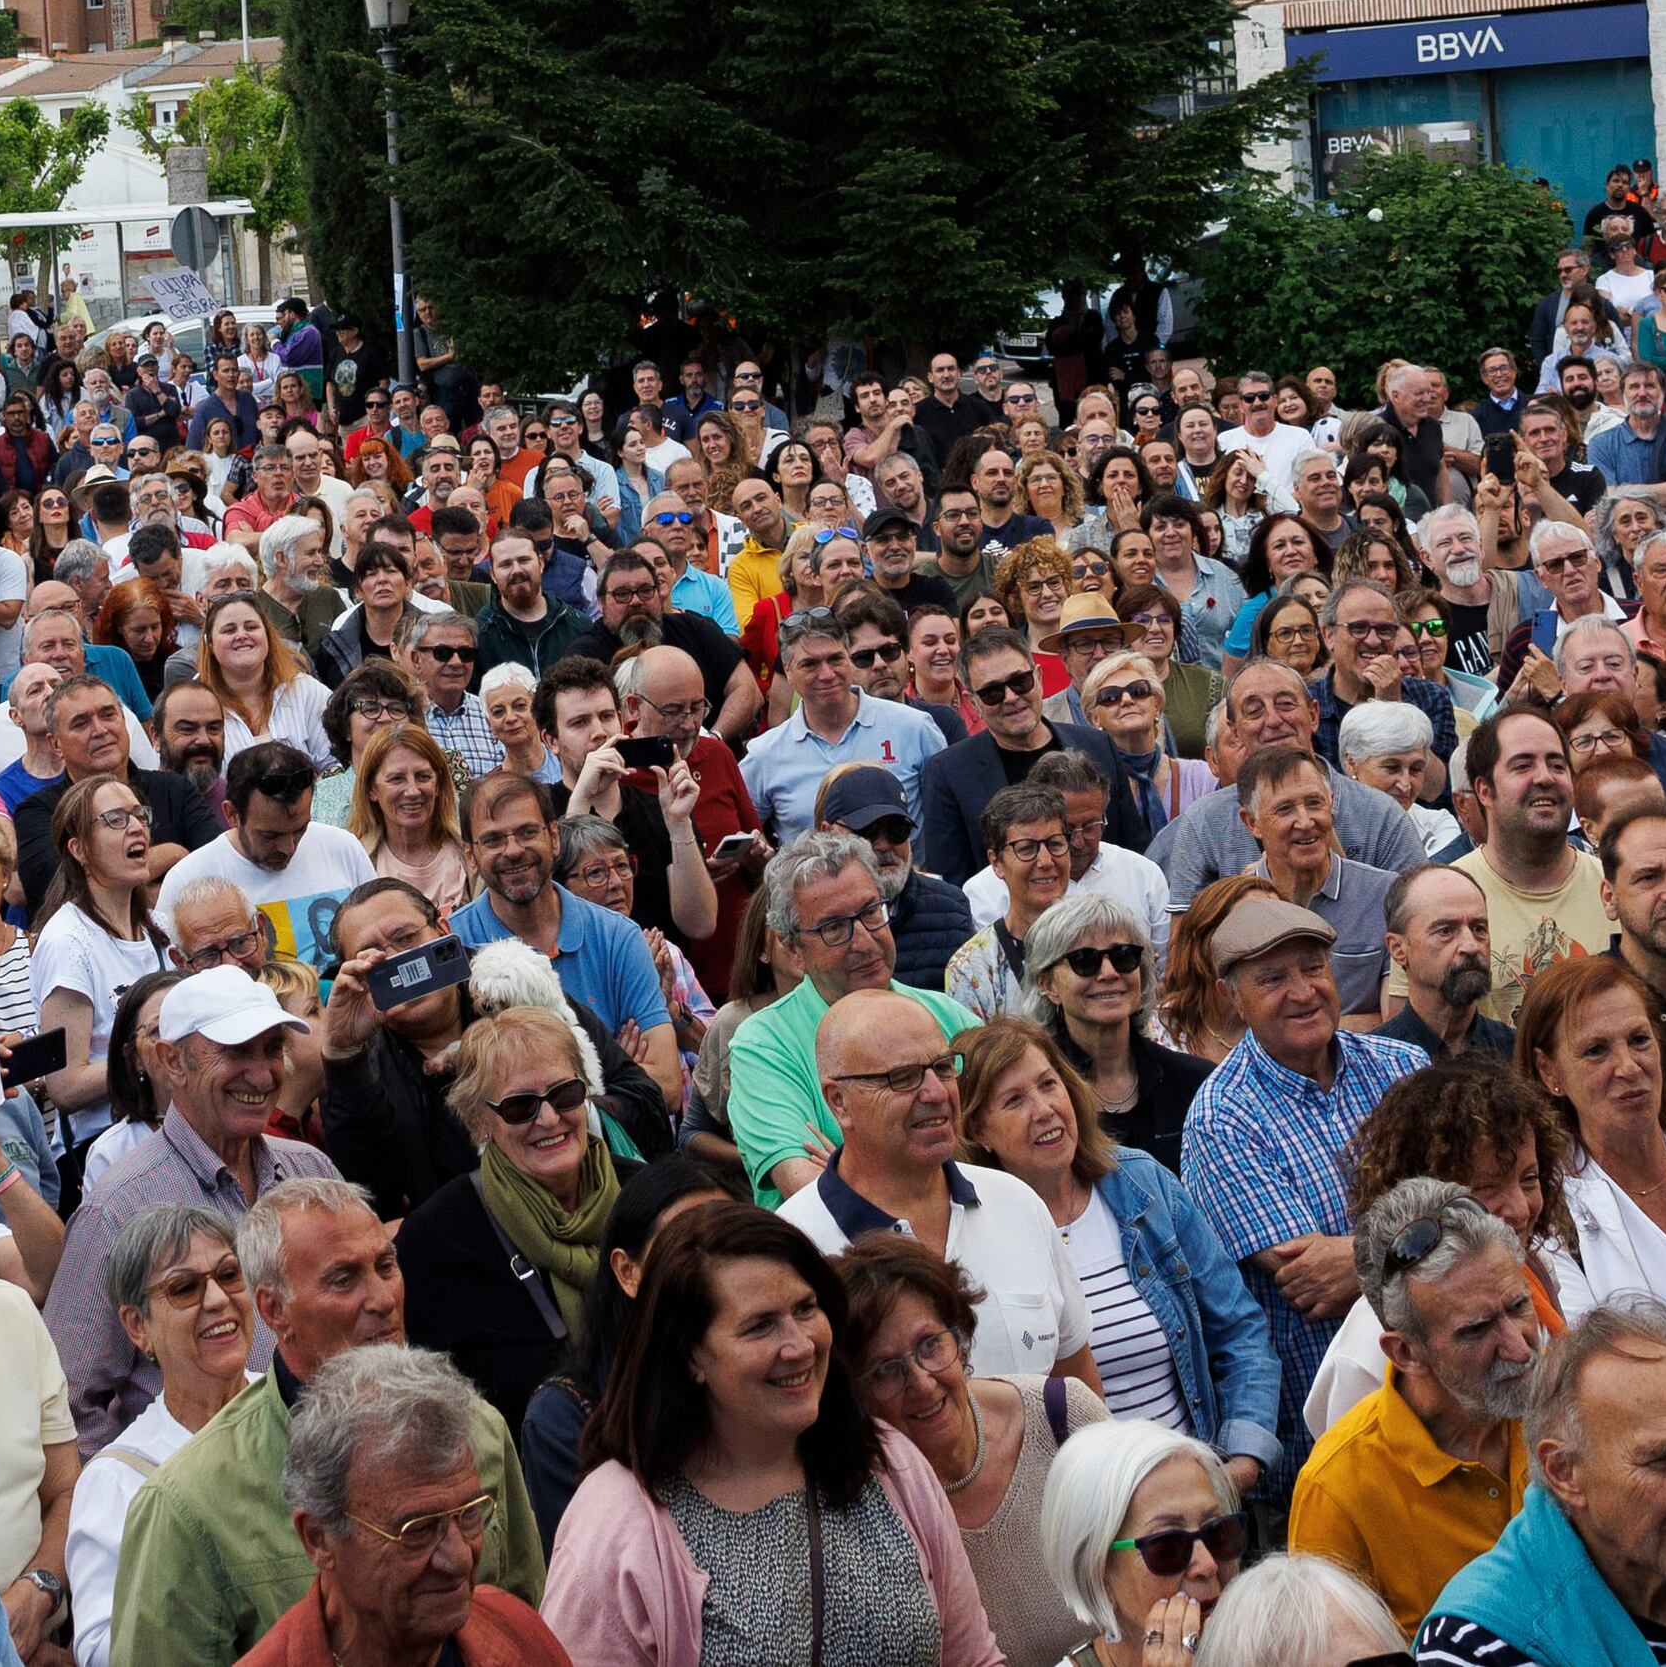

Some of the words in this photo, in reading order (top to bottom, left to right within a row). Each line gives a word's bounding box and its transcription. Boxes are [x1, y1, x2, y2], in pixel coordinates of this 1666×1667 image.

[1416, 25, 1504, 62] BBVA
[1328, 133, 1374, 154] BBVA
[151, 273, 201, 296] CULTURA
[175, 288, 198, 302] SIN
[169, 297, 219, 319] CENSURA
[880, 739, 896, 761] 1
